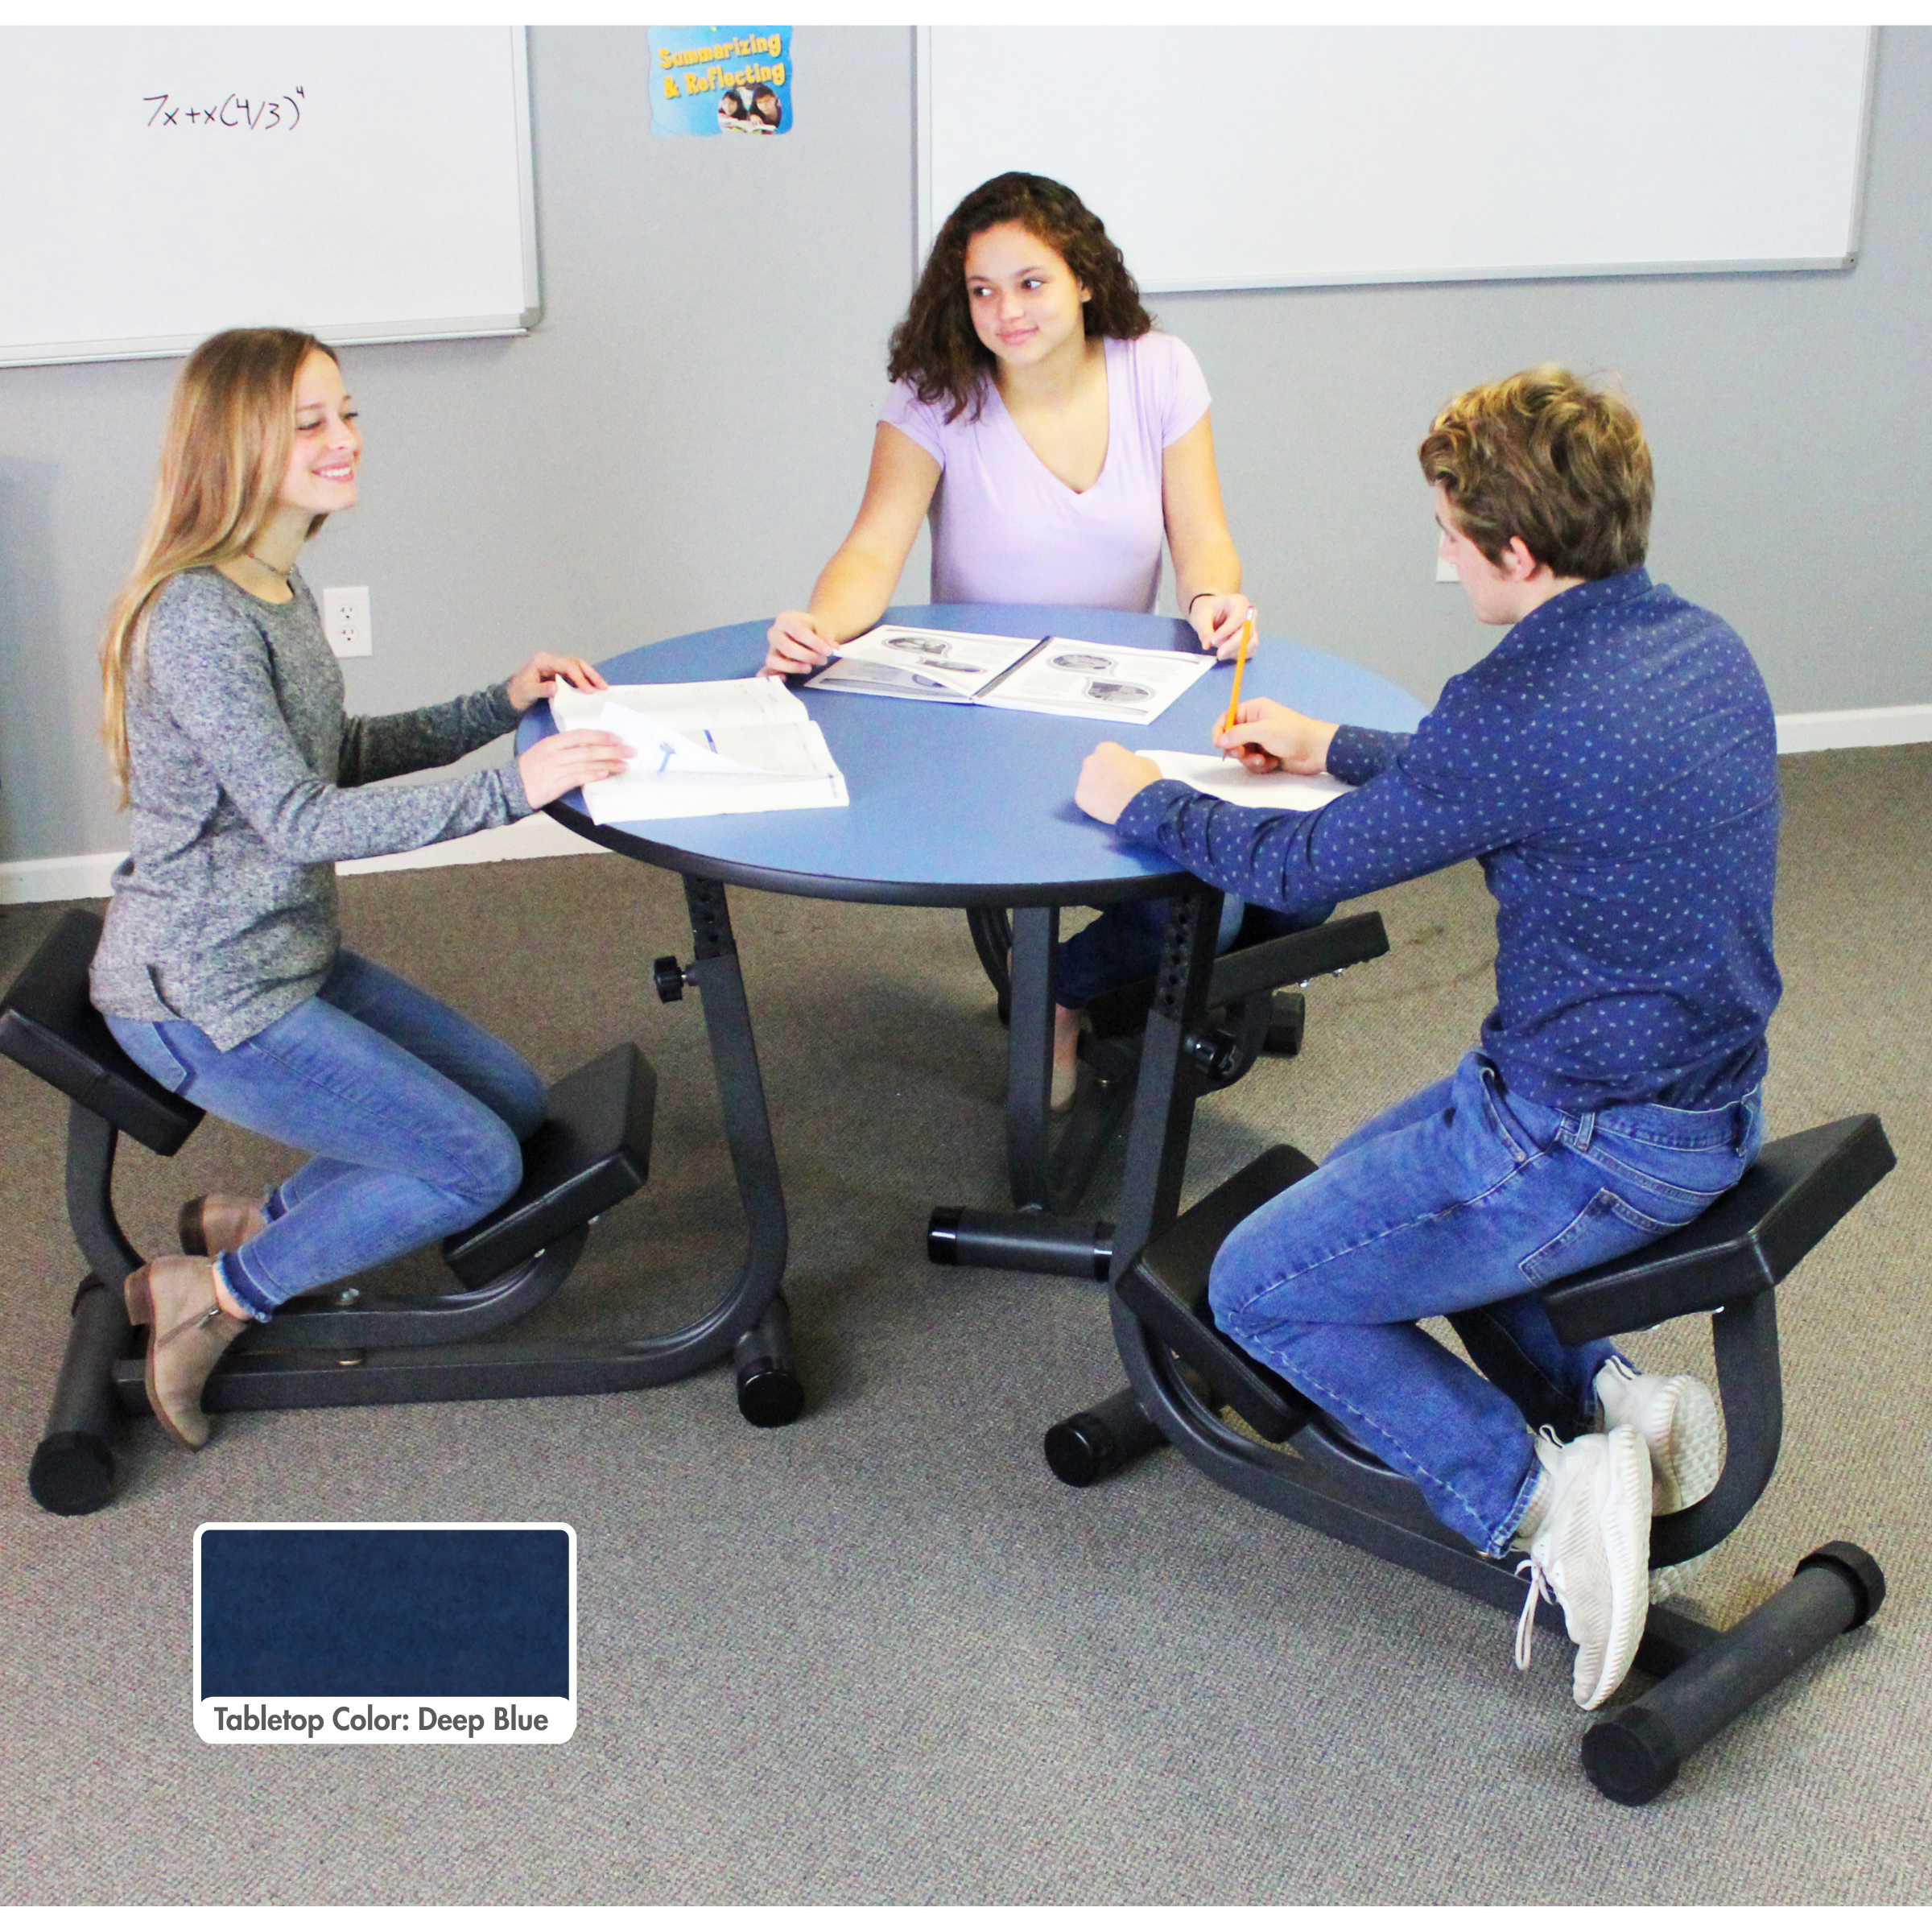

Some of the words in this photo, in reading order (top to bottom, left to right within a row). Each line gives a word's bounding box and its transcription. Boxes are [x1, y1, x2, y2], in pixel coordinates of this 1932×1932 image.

[658, 34, 782, 70] Summarizing
[663, 76, 681, 99] &
[684, 62, 786, 96] Reflecting
